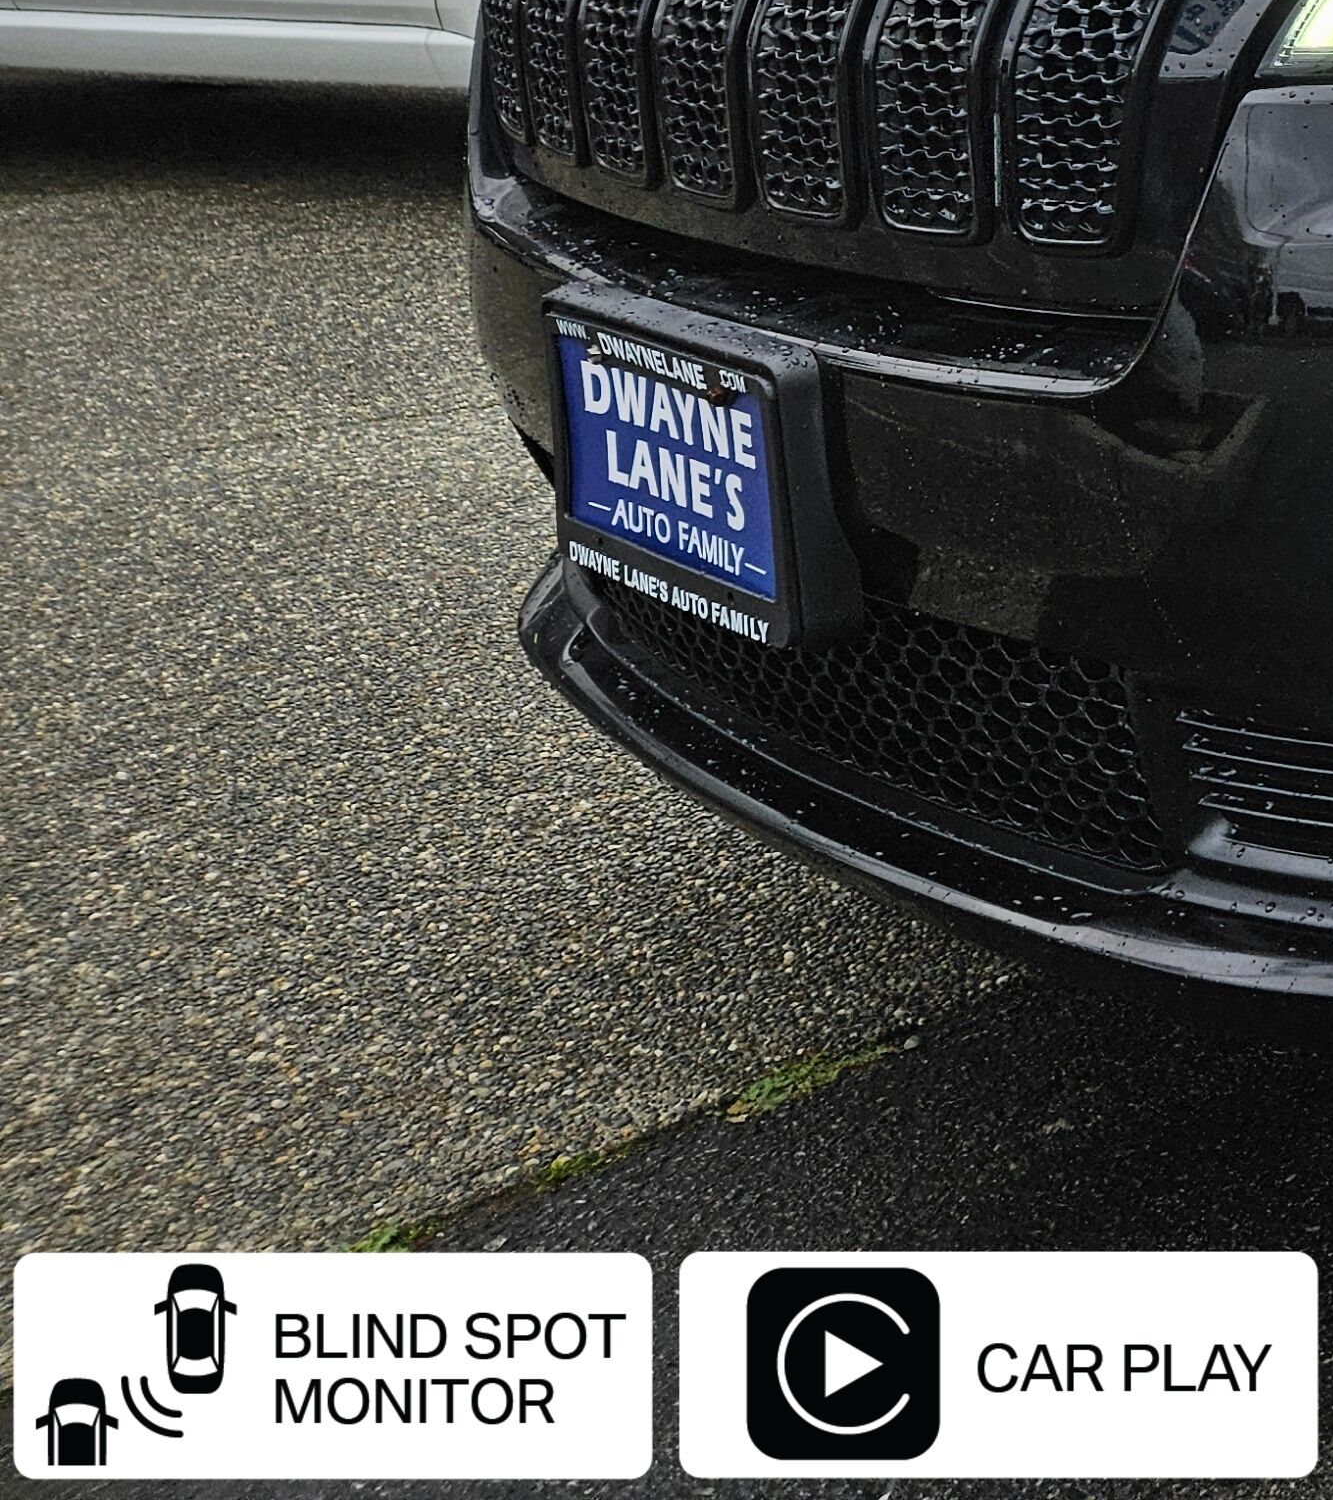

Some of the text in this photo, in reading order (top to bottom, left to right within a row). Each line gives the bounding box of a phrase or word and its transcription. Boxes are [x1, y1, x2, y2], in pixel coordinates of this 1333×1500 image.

[581, 359, 756, 470] DWAYNE
[606, 429, 745, 532] LANE'S
[611, 499, 744, 576] AUTO FAMILY
[569, 540, 769, 644] DWAYNE LANE'S AUTO FAMILY
